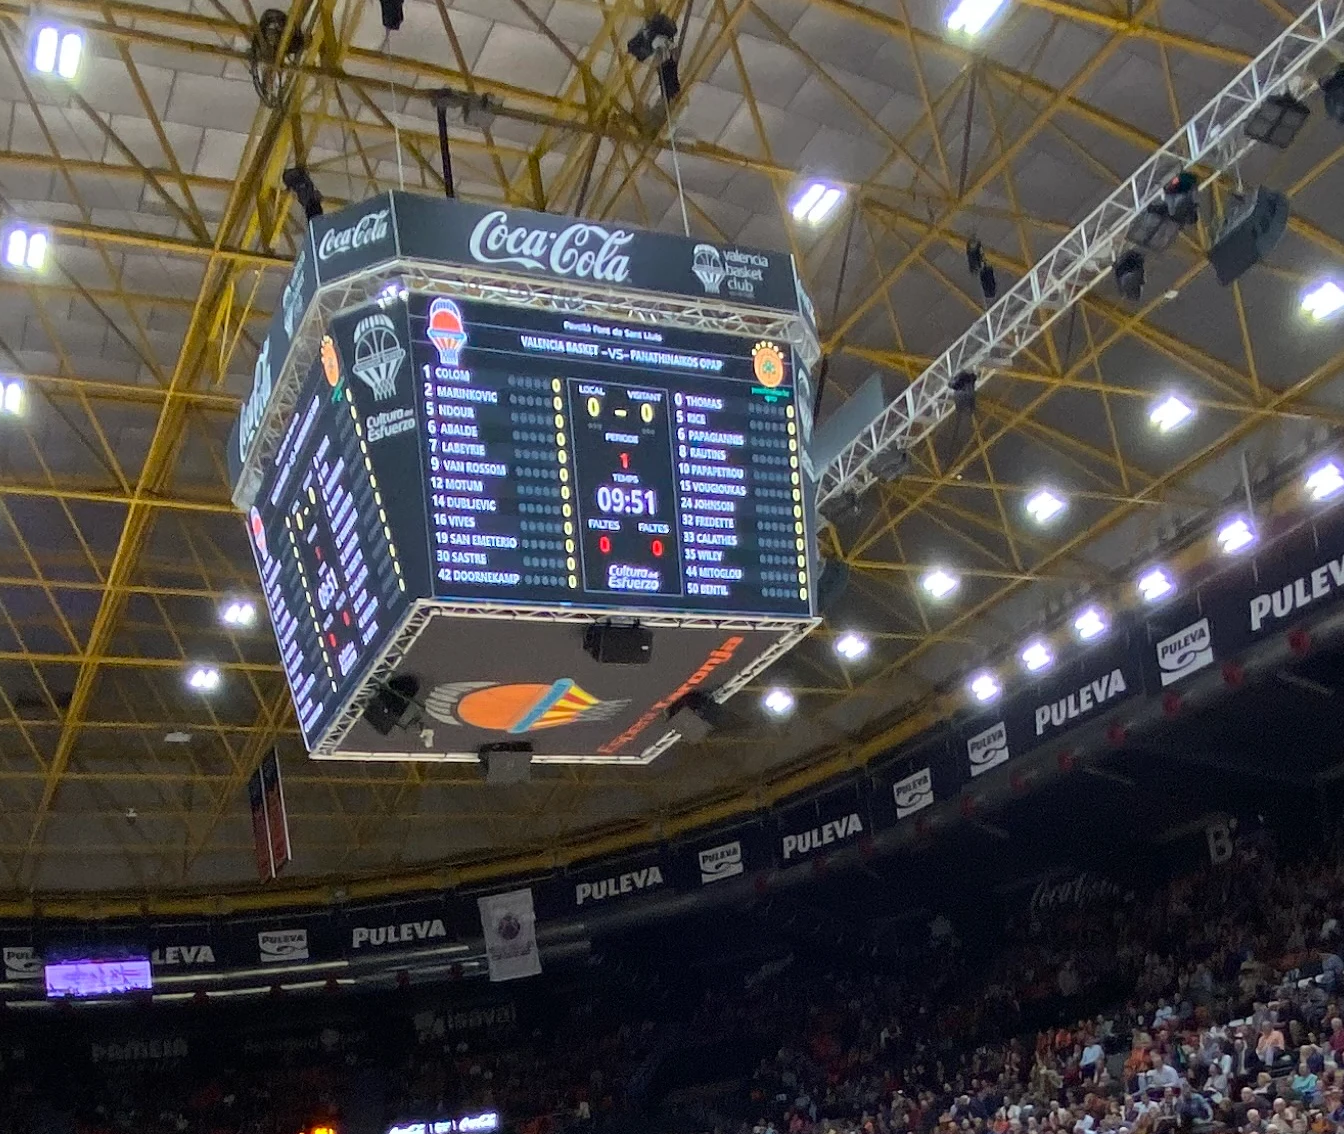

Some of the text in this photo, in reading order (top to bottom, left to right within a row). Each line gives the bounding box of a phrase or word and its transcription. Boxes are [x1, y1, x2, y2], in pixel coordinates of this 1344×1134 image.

[723, 249, 769, 268] valencia
[725, 264, 764, 281] basket
[727, 277, 754, 292] club
[521, 335, 564, 352] VALENCIA
[566, 342, 598, 356] BASKET
[630, 349, 698, 369] PANATHINAIKOS
[423, 364, 470, 382] 1 COLOM
[424, 383, 497, 404] 2 MARINKOVIC
[578, 385, 605, 395] LOCAL
[587, 397, 600, 417] 0
[675, 393, 723, 409] 0 THOMAS
[366, 409, 403, 428] Cultura
[426, 402, 475, 418] 5 NDOUR
[641, 403, 653, 423] 0
[676, 410, 706, 425] 5 RICE
[367, 417, 416, 442] Esfuerzo
[428, 420, 478, 437] 6 ABALDE
[677, 428, 744, 446] 6 PAPAGIANNIS
[429, 438, 437, 453] 7
[679, 445, 726, 460] 8 RAUTINS
[430, 456, 506, 476] 9 VAN ROSSOM
[620, 452, 628, 469] 1
[612, 473, 639, 484] TEMPS
[679, 463, 744, 479] 10 PAPAPETROU
[430, 477, 483, 492] 12 MOTUM
[680, 480, 746, 497] 15 VOUGIOUKAS
[432, 495, 496, 512] 14 DUBLJEVIC
[597, 487, 656, 515] 09:51
[681, 497, 735, 512] 24 JOHNSON
[434, 513, 475, 528] 16 VIVES
[588, 518, 620, 531] FALTES
[638, 523, 670, 534] FALTES
[682, 514, 735, 529] 32 FREDETTE
[435, 532, 517, 549] 19 SAN EMETERIO
[599, 536, 611, 553] 0
[684, 531, 738, 546] 33 CALATHES
[652, 540, 663, 556] 0
[685, 549, 723, 562] 35 WILEY
[437, 550, 487, 565] 30 SASTRE
[438, 569, 520, 585] 42 DOORNEKAMP
[608, 565, 647, 578] Cultura
[686, 566, 743, 580] 44 MITOGLOU
[608, 576, 659, 590] Esfuerzo
[687, 583, 729, 596] 50 BENTIL
[1160, 626, 1207, 657] PULEVA
[1035, 669, 1127, 736] PULEVA
[970, 729, 1004, 754] PULEVA
[896, 774, 929, 796] PULEVA
[782, 813, 863, 859] PULEVA
[702, 846, 739, 864] PULEVA
[575, 866, 664, 905] PULEVA
[260, 933, 306, 946] PULEVA
[352, 919, 447, 949] PULEVA
